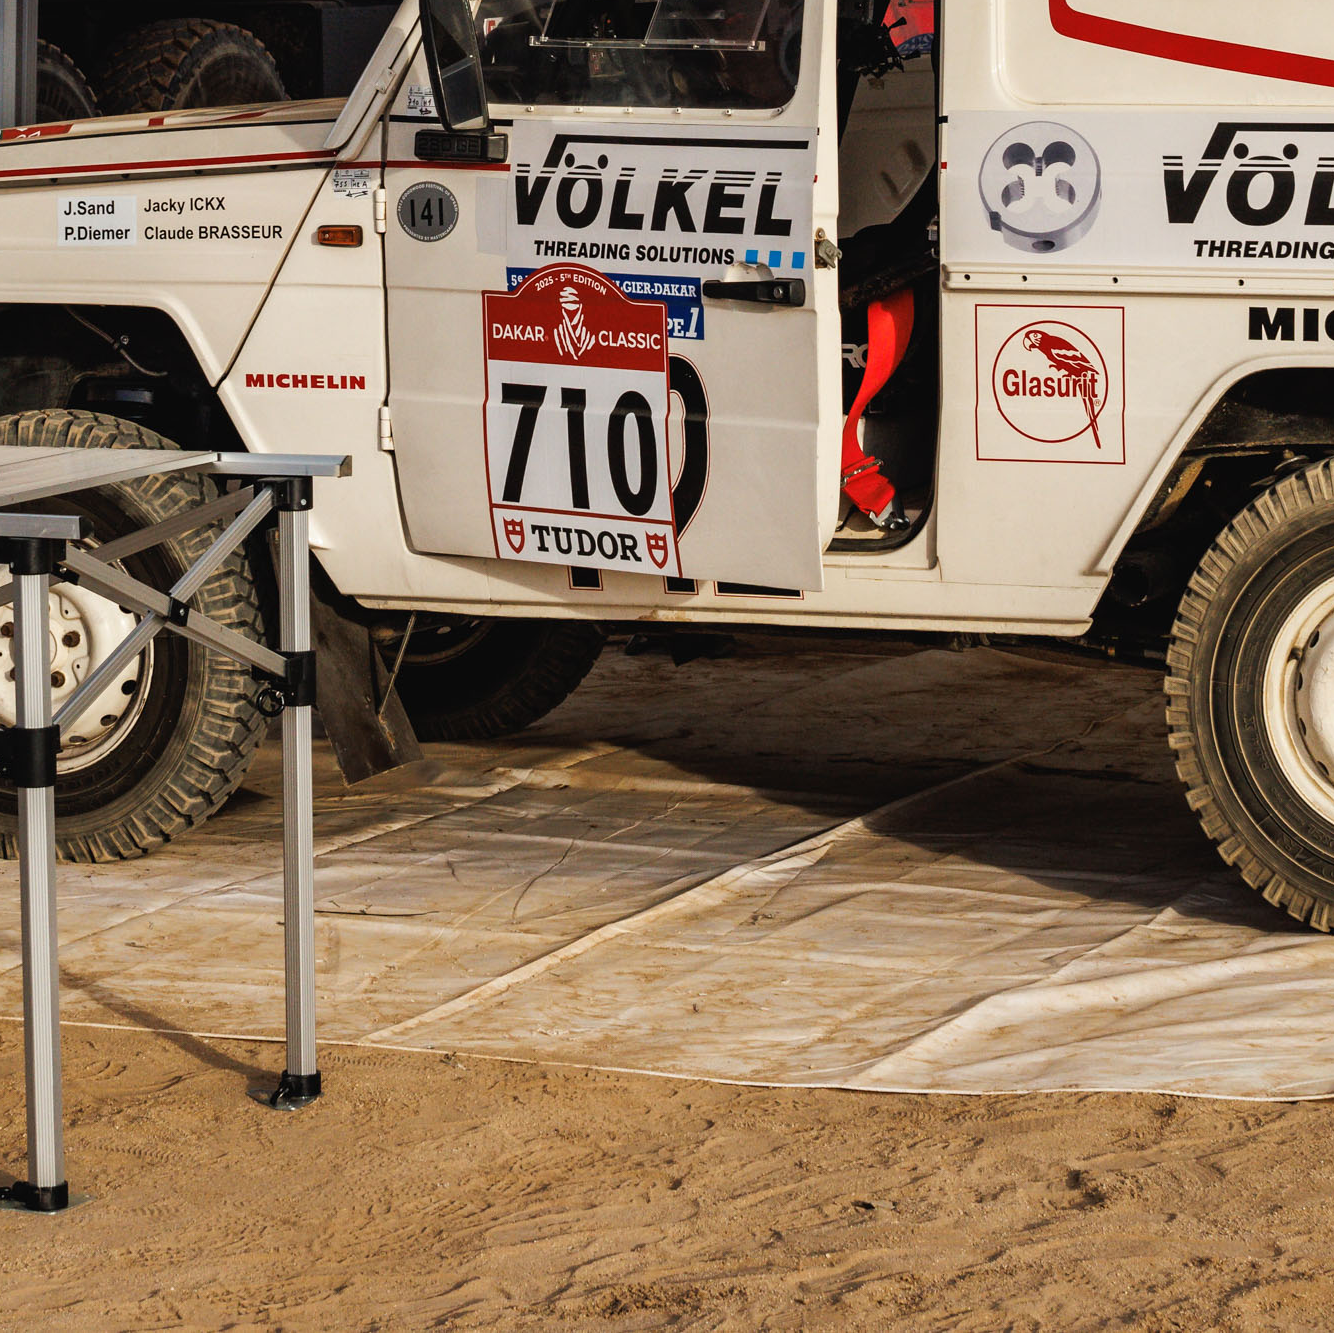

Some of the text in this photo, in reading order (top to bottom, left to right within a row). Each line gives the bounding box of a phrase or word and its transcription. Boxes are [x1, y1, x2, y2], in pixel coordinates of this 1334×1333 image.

[514, 134, 809, 236] VÖLKEL
[64, 200, 115, 215] J.Sand
[144, 197, 225, 215] Jacky ICKX
[410, 198, 444, 227] 141
[64, 226, 130, 240] P.Diemer
[144, 225, 282, 239] Claude BRASSEUR
[534, 239, 735, 265] THREADING SOLUTIONS
[535, 277, 554, 292] 2025
[573, 274, 607, 295] EDITION
[613, 279, 697, 297] GIER-DAKAR
[493, 323, 661, 350] DAKAR CLASSIC
[246, 374, 365, 389] MICHELIN
[1002, 369, 1098, 398] Glasurit
[501, 382, 657, 516] 710
[531, 524, 642, 562] TUDOR
